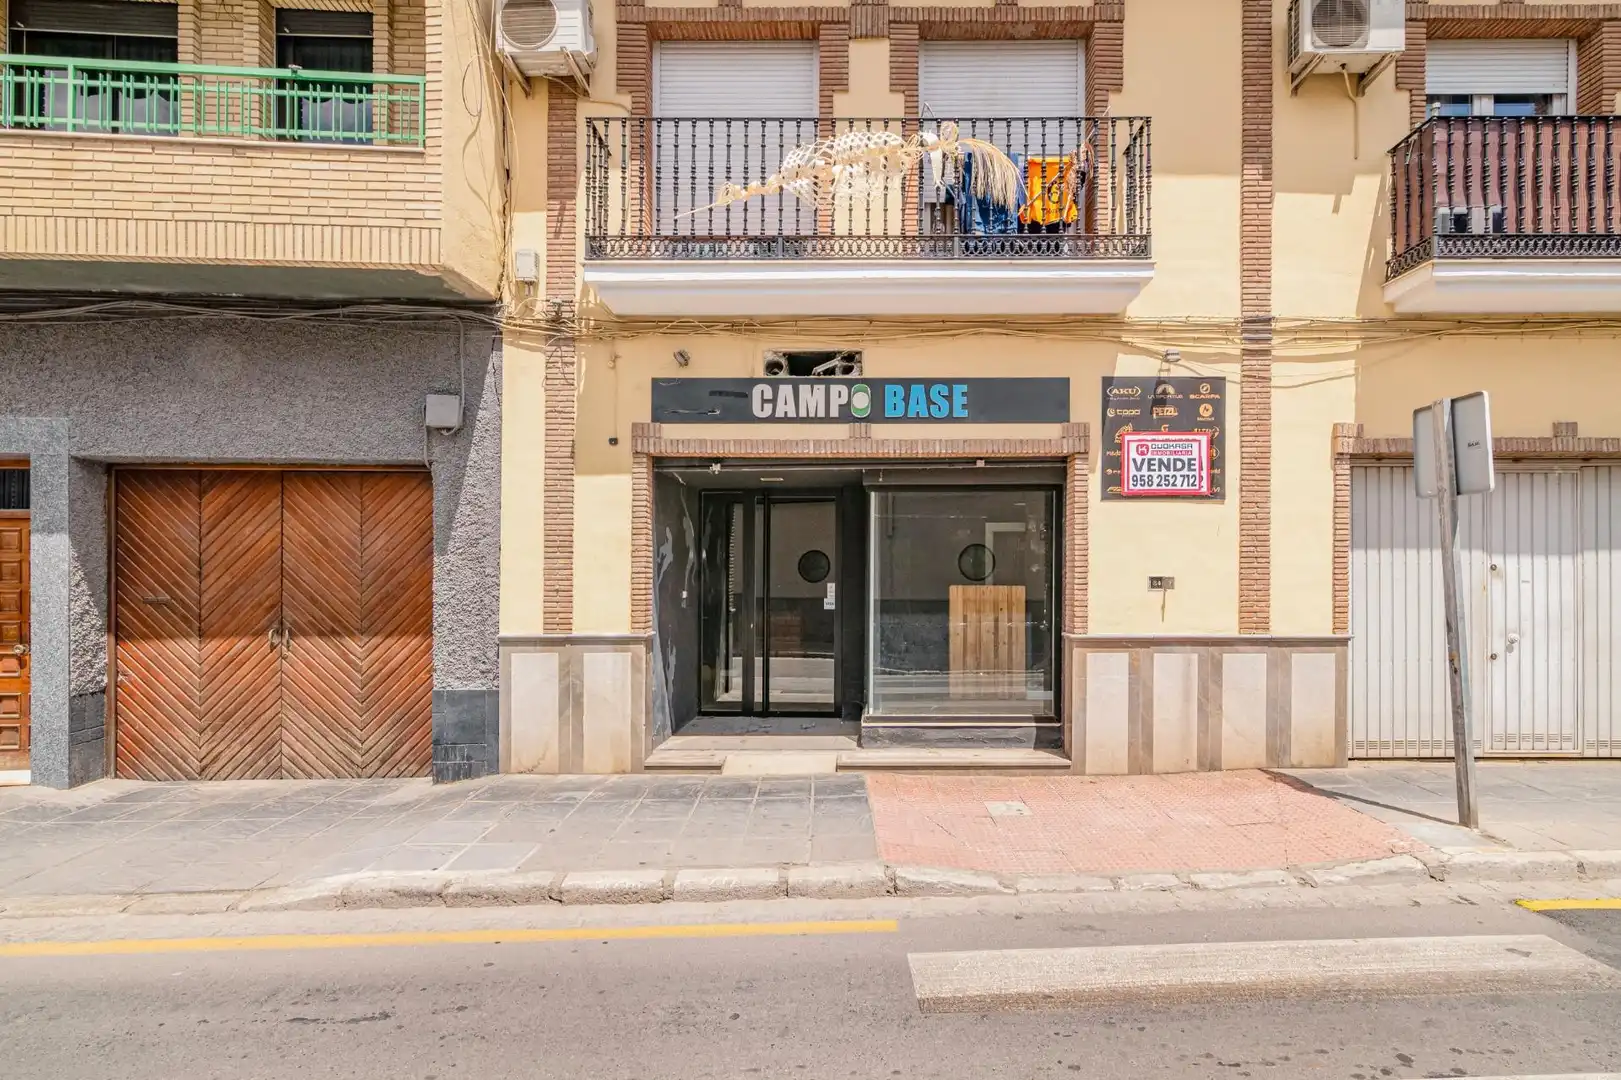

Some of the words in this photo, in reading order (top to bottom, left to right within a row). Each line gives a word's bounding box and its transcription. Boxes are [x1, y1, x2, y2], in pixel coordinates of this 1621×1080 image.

[752, 382, 872, 418] CAMPO
[884, 383, 969, 417] BASE
[1131, 457, 1197, 472] VENDE
[1131, 474, 1154, 488] 958
[1156, 474, 1177, 488] 252
[1179, 474, 1197, 488] 712
